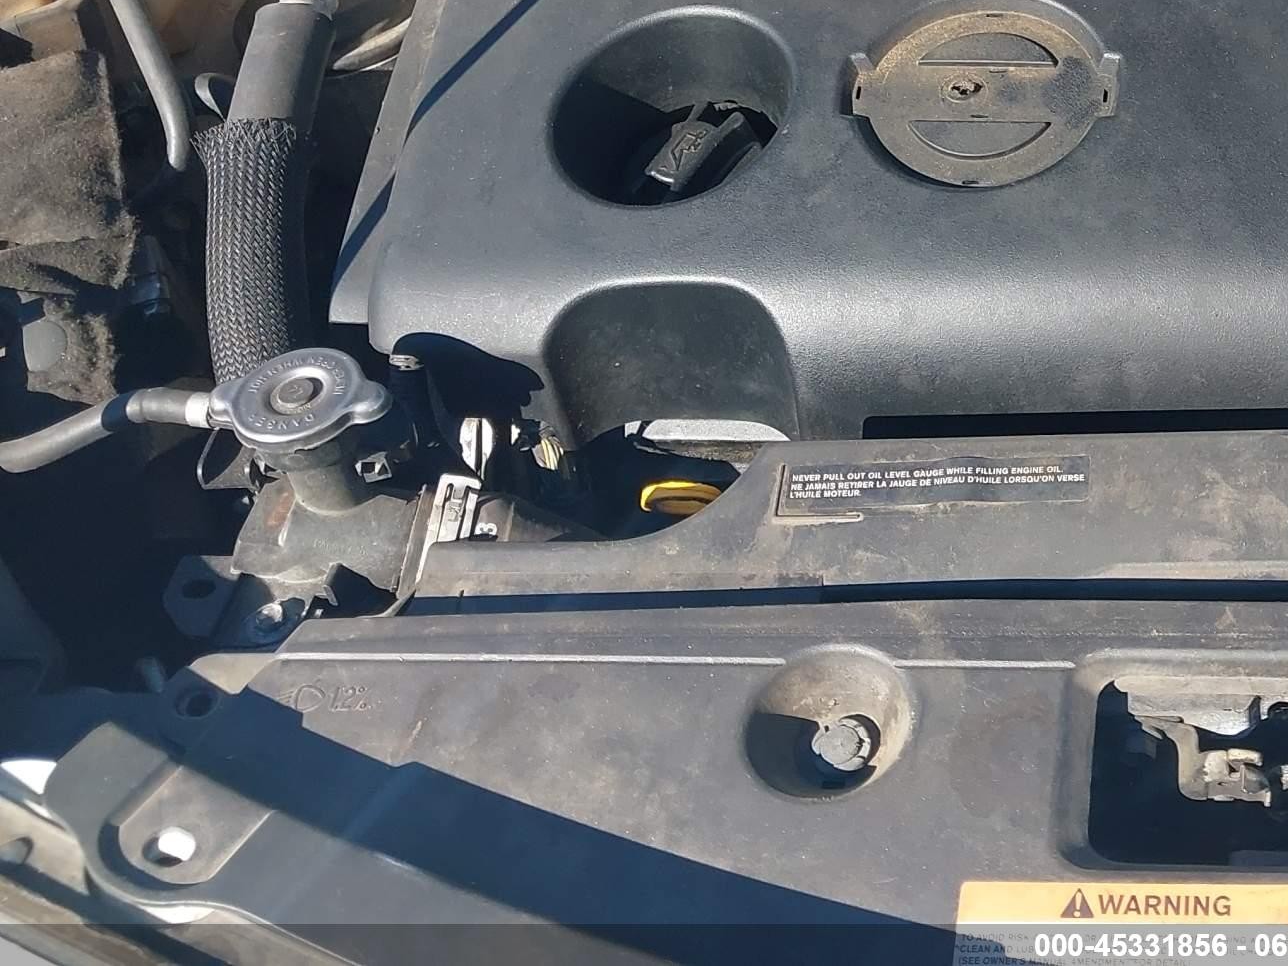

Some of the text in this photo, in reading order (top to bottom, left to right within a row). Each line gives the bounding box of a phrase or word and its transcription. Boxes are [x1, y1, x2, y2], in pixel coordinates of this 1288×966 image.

[792, 465, 1063, 482] NEVER PULL OUT OIL LEVEL GAUGE WHILE FILLING ENGINE OIL.
[790, 474, 1085, 491] NE JAMAIS RETIRER LA JAUGE DE NIVEAU D'HUILE LORSQU'ON VERSE
[790, 490, 821, 498] L'HUILE
[1098, 894, 1232, 916] WARNING
